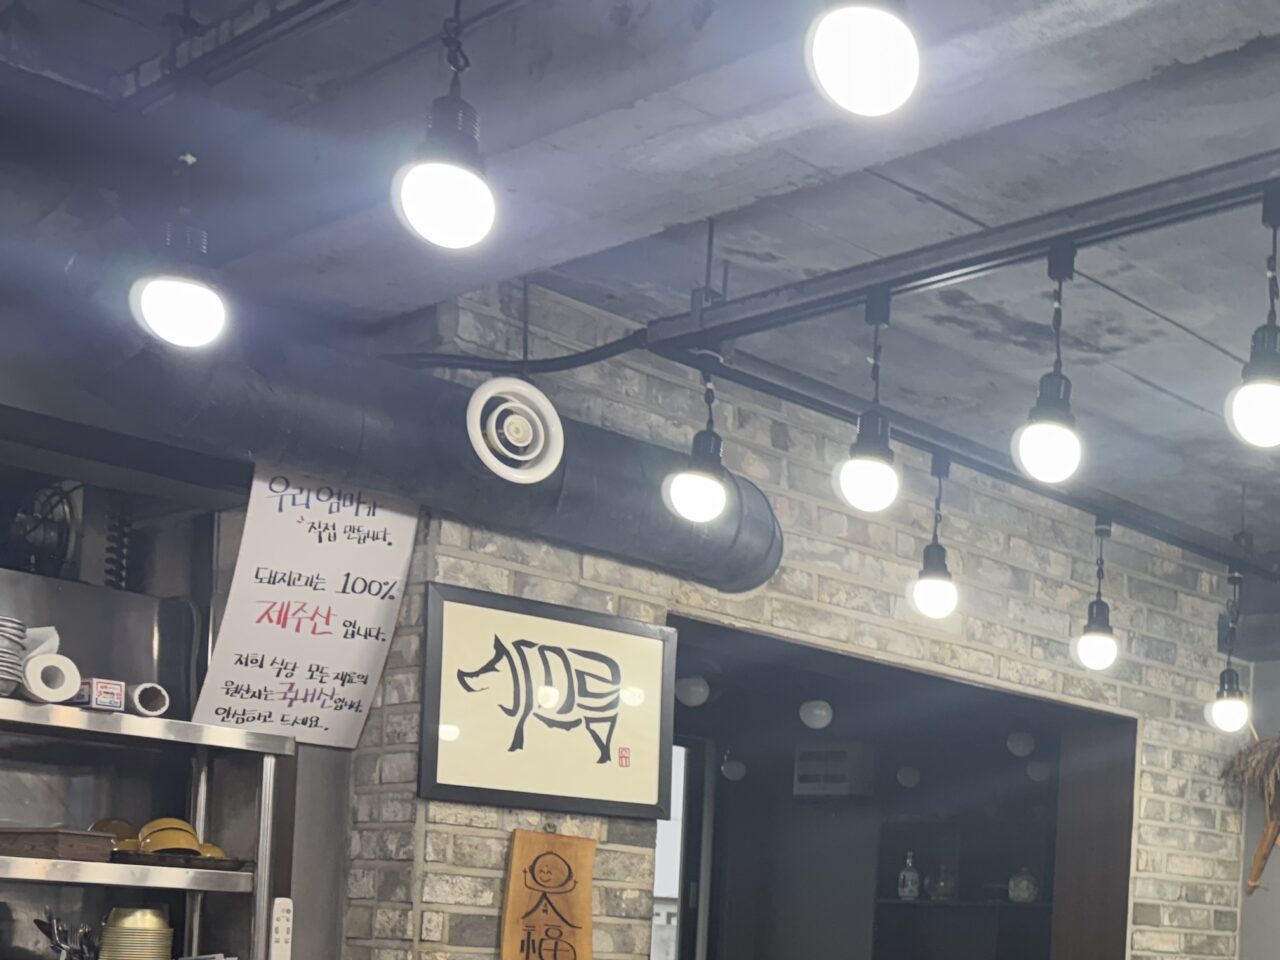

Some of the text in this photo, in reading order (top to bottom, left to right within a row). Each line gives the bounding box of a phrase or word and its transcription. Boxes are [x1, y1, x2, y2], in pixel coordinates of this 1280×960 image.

[265, 475, 376, 516] 우리 엄마가
[307, 520, 393, 546] 직접 만듭니다.
[254, 566, 397, 601] 돼지고기는 100%
[255, 600, 386, 642] 제주산 입니다.
[233, 652, 369, 687] 저희 식당 모든 재료의
[220, 680, 275, 701] 원산지는
[214, 706, 329, 731] 안심하고 드세요.
